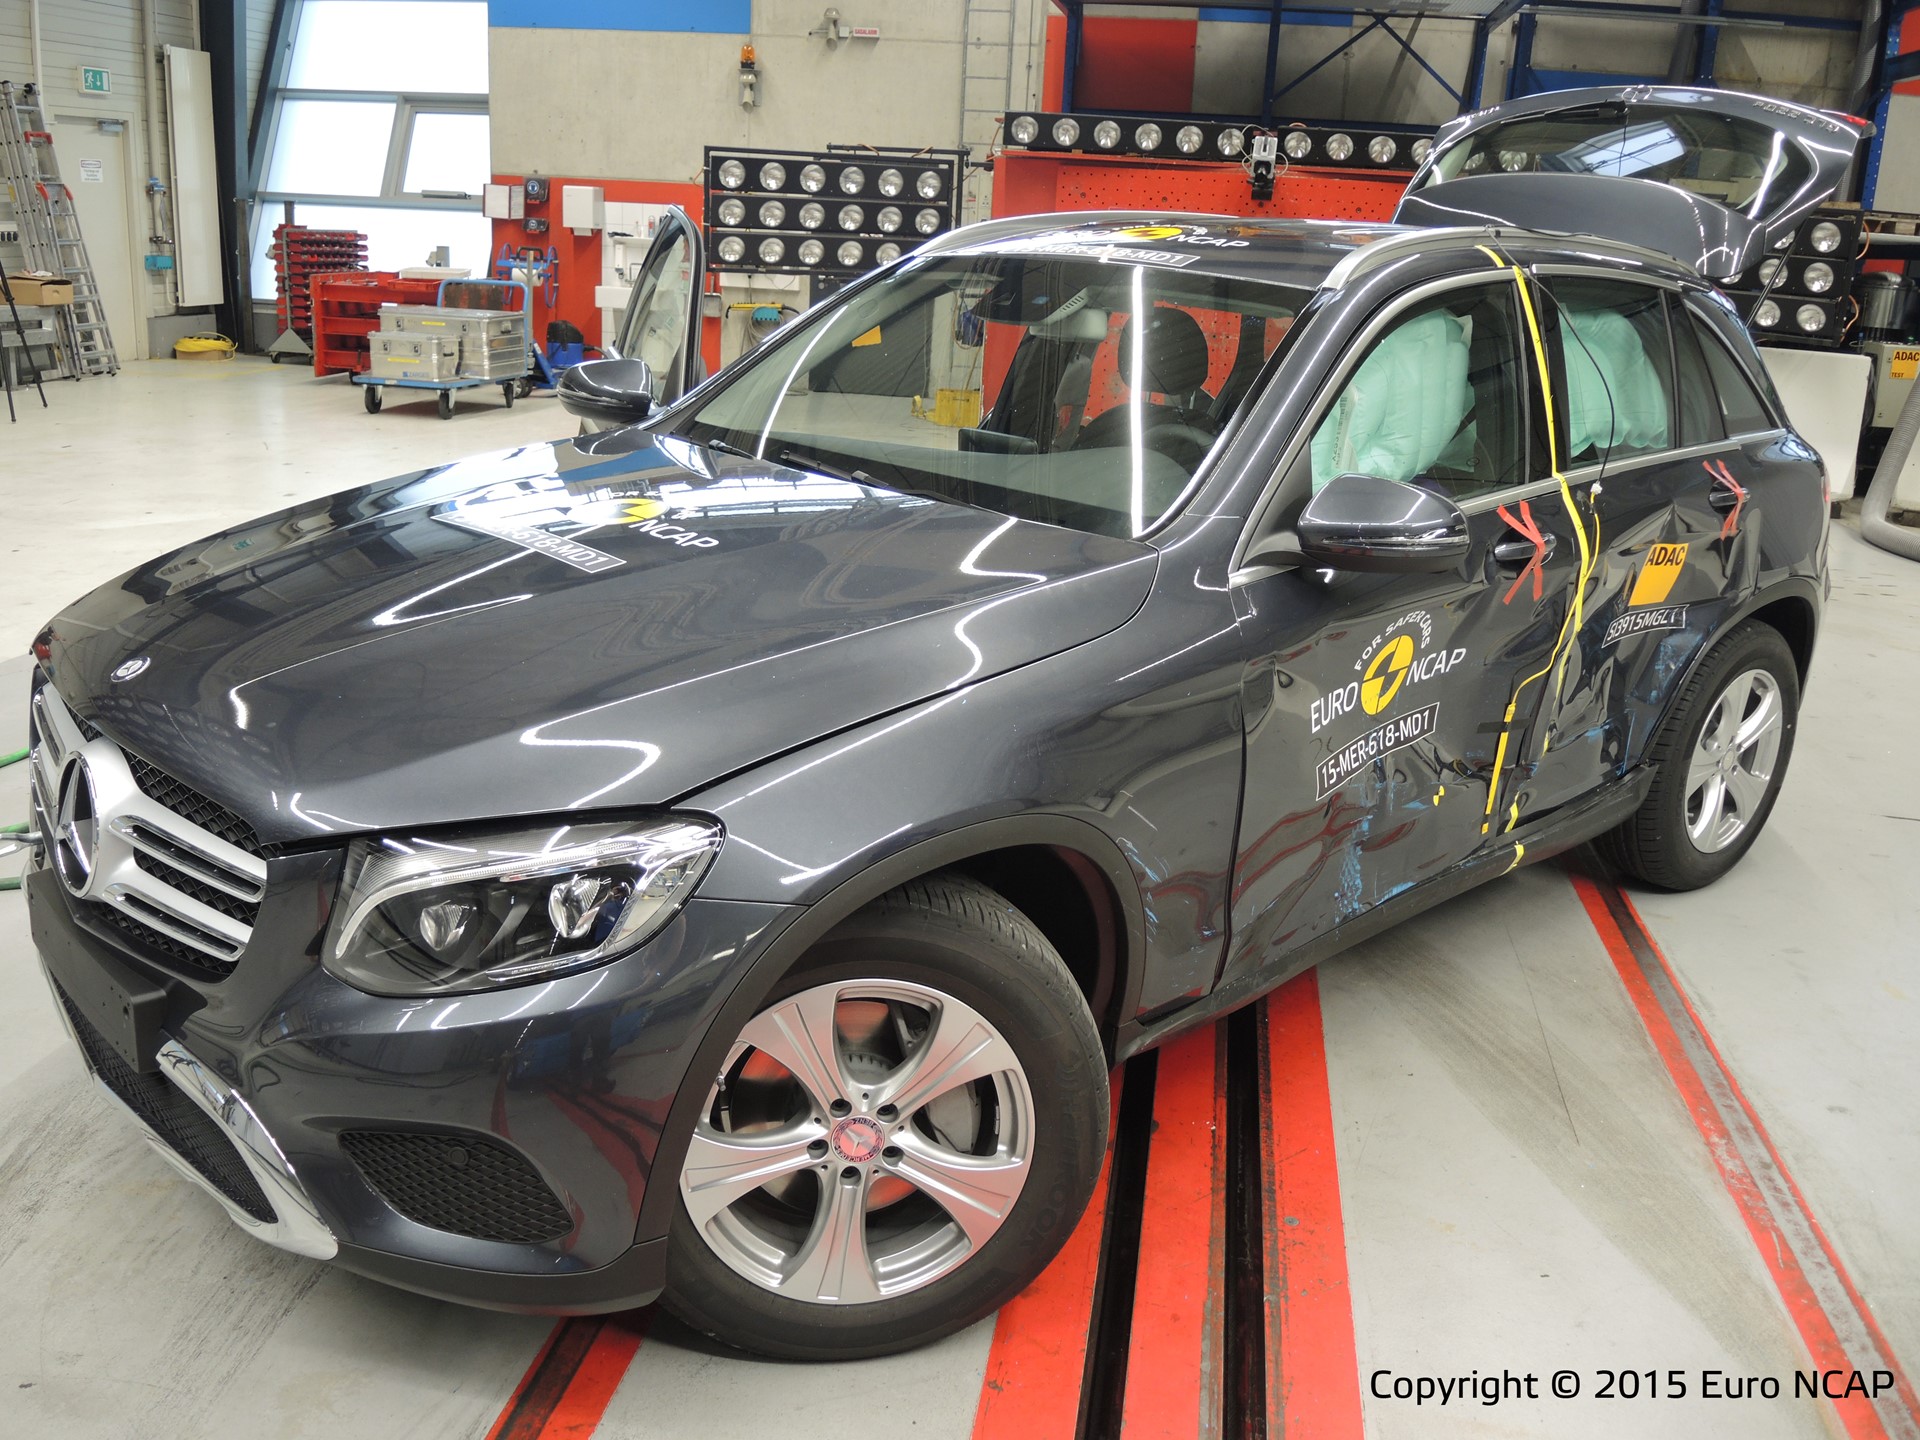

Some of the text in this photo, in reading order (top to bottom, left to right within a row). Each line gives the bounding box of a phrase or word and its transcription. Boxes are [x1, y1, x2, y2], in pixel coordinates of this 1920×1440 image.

[1166, 234, 1250, 248] NCAP
[1894, 351, 1920, 361] ADAC
[628, 519, 720, 549] NCAP
[1645, 546, 1686, 566] ADAC
[1354, 610, 1432, 671] FOR SAFER CARS
[1311, 648, 1467, 734] EURO NCAP
[1321, 709, 1430, 789] 15-MER-618-MD1
